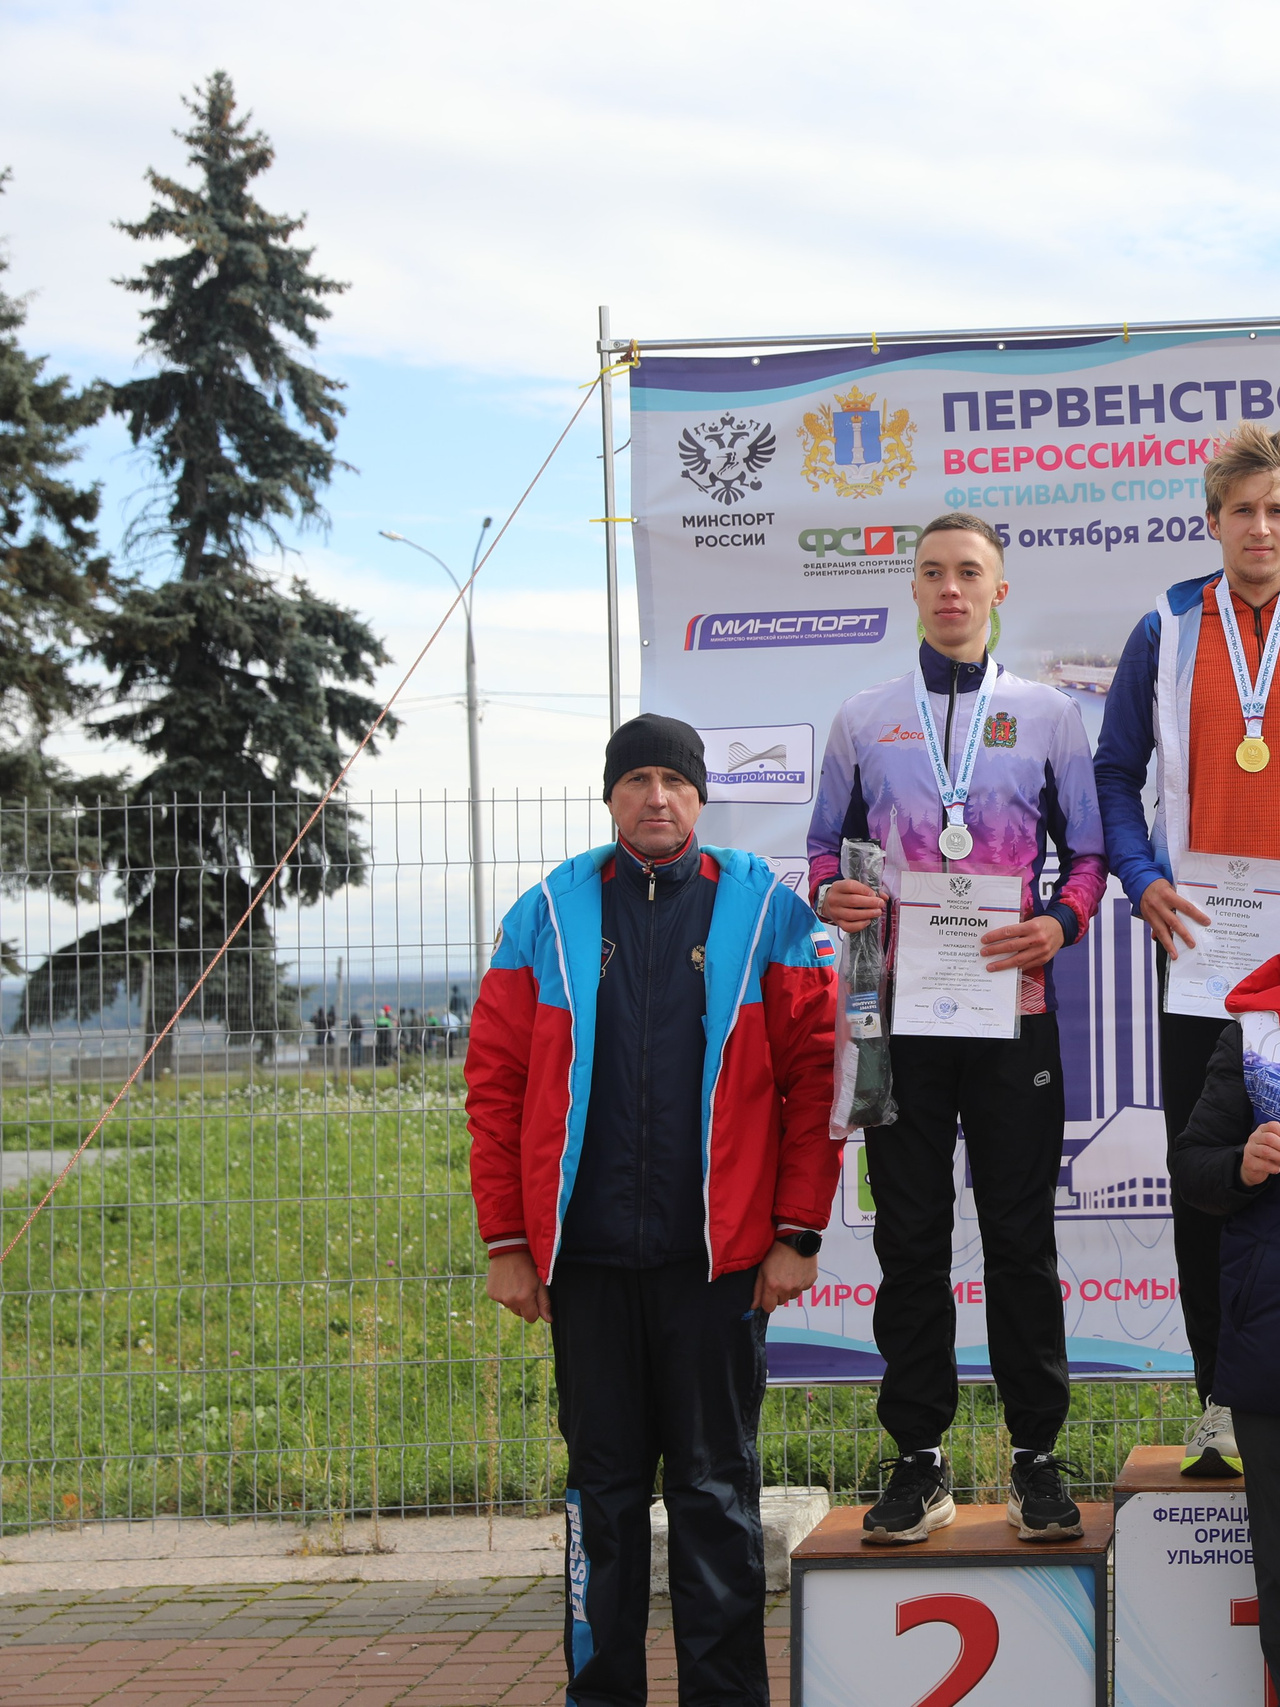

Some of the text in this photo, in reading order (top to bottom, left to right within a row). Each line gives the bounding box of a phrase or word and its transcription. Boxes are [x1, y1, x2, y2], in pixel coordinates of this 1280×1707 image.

[943, 481, 1105, 509] ФЕСТИВАЛЬ
[681, 512, 776, 529] МИНСПОРТ
[694, 532, 766, 548] РОССИИ
[1018, 520, 1139, 553] октября
[803, 558, 914, 570] ФЕДЕРАЦИЯ СПОРТИВНО
[803, 567, 886, 577] ОРИЕНТИРОВАНИЯ
[711, 614, 880, 636] МИНСПОРТ
[1205, 895, 1263, 910] ДИПЛОМ
[929, 915, 988, 928] ДИПЛОМ
[1219, 911, 1251, 919] степень
[945, 930, 978, 938] степень
[1228, 930, 1260, 938] ВЛАДИСЛАВ
[1079, 1277, 1180, 1302] ОСМЫ
[1194, 1528, 1251, 1543] ОРИЕ
[1167, 1549, 1254, 1565] УЛЬЯНОВ
[896, 1592, 1000, 1707] 2
